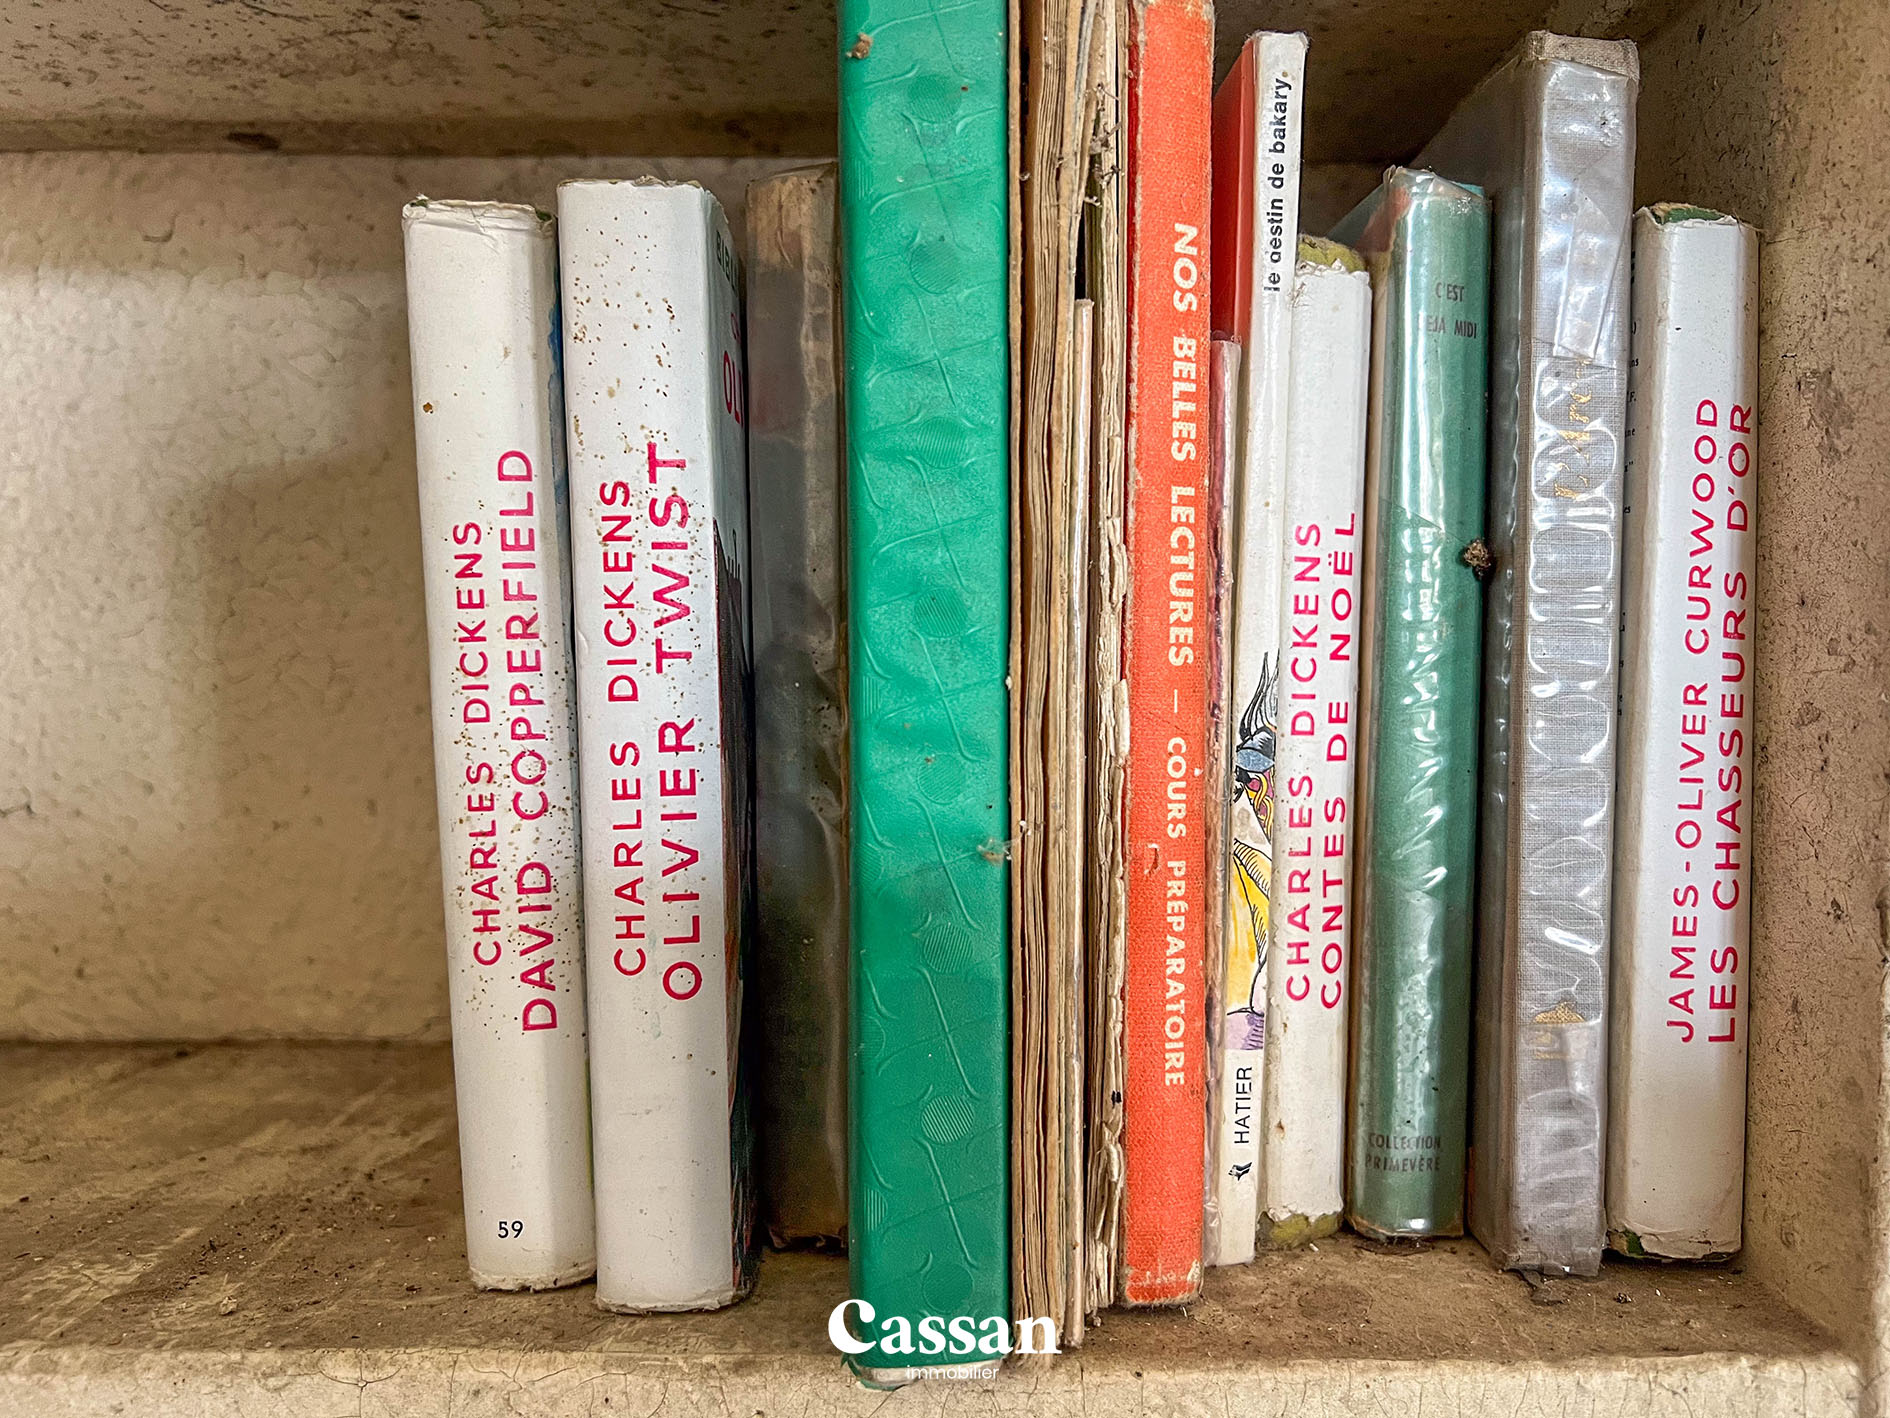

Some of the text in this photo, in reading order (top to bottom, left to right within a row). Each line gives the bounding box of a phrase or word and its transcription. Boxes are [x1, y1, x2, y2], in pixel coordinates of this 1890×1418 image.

[1267, 162, 1285, 190] de
[1172, 221, 1199, 313] NOS
[1263, 270, 1282, 292] le
[1434, 281, 1465, 303] C'EST
[1453, 319, 1478, 339] MIDI
[1171, 335, 1198, 462] BELLES
[1167, 484, 1196, 667] LECTURES
[1684, 398, 1719, 656] CURWOOD
[452, 520, 501, 967] CHARLES DICKENS
[497, 448, 559, 1032] DAVID COPPERFIELD
[599, 479, 647, 978] CHARLES DICKENS
[646, 441, 703, 1002] OLIVIER TWIST
[1284, 522, 1322, 1003] CHARLES DICKENS
[1320, 511, 1356, 1011] CONTES DE NOËL
[1707, 403, 1752, 1044] LES CHASSEURS D'OR
[1166, 736, 1188, 839] COURS
[1163, 860, 1189, 1087] PRÉPARATOIRE
[1233, 1066, 1253, 1144] HATIER
[1365, 1153, 1441, 1172] PRIMEVÈRE
[1367, 1132, 1441, 1150] COLLECTION
[497, 1219, 524, 1239] 59
